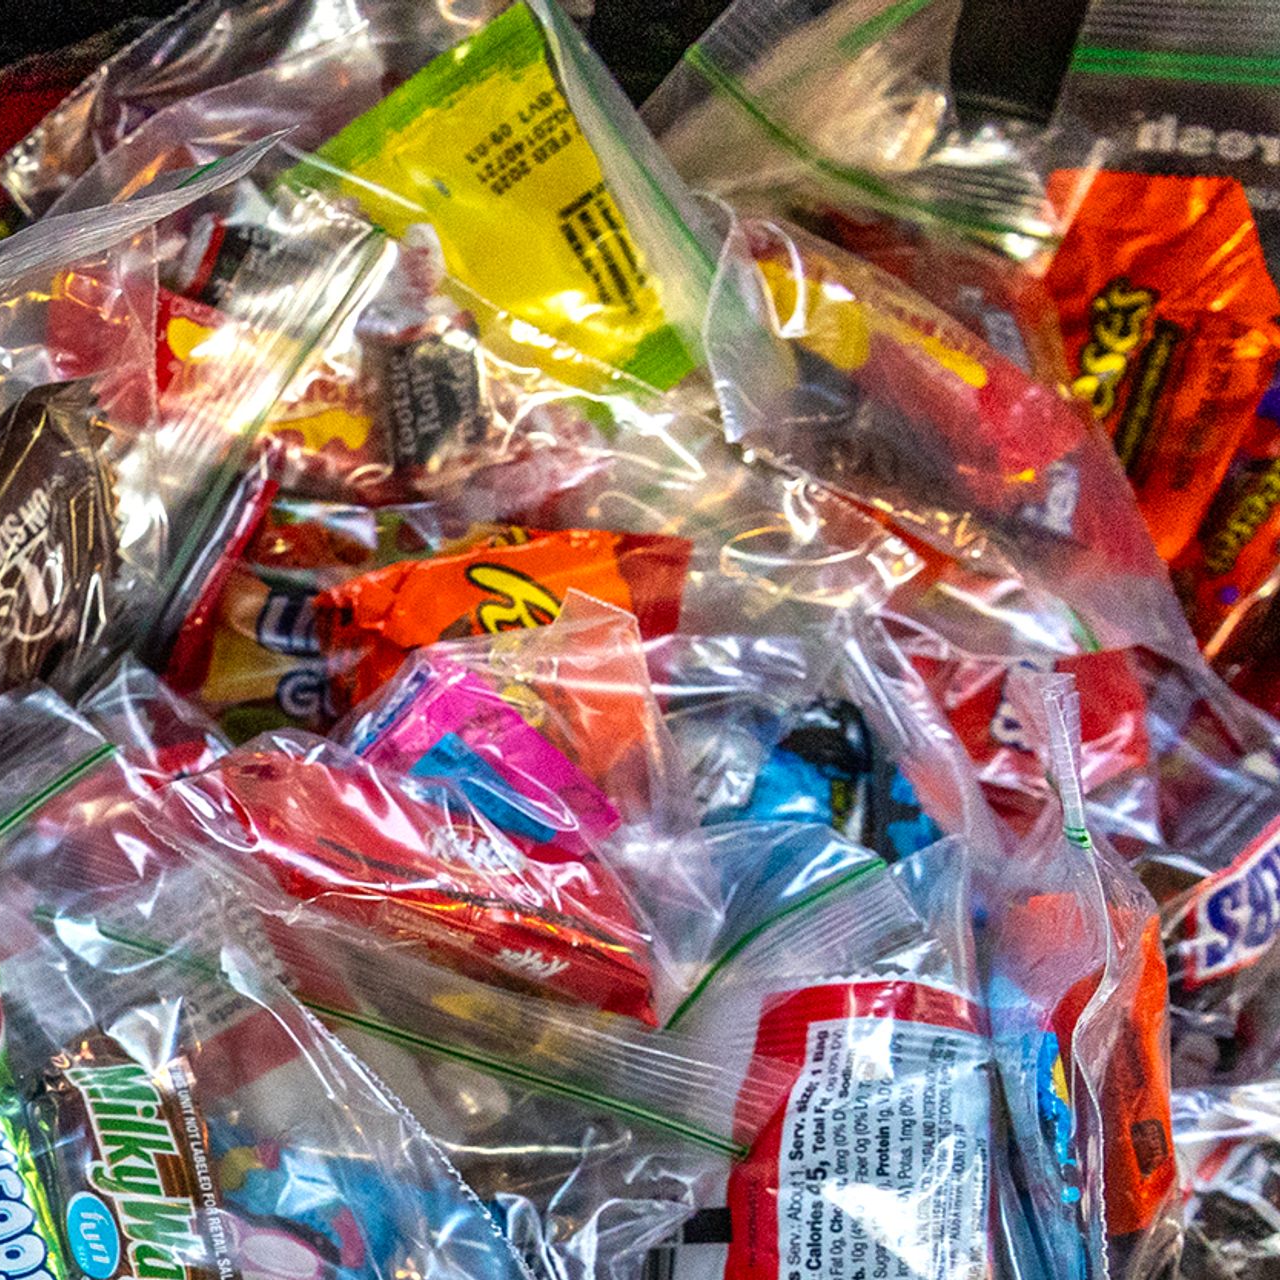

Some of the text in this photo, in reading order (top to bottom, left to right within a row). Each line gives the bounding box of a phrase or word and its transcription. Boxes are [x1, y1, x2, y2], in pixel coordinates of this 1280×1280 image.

[175, 1087, 192, 1111] UNIT
[182, 1114, 198, 1133] NOT
[70, 1064, 180, 1194] Milky
[876, 1124, 890, 1177] Protein
[188, 1136, 211, 1187] LABELED
[202, 1190, 217, 1212] FOR
[805, 1119, 826, 1270] Calories Total
[79, 1208, 111, 1267] fun
[208, 1215, 227, 1254] RETAIL
